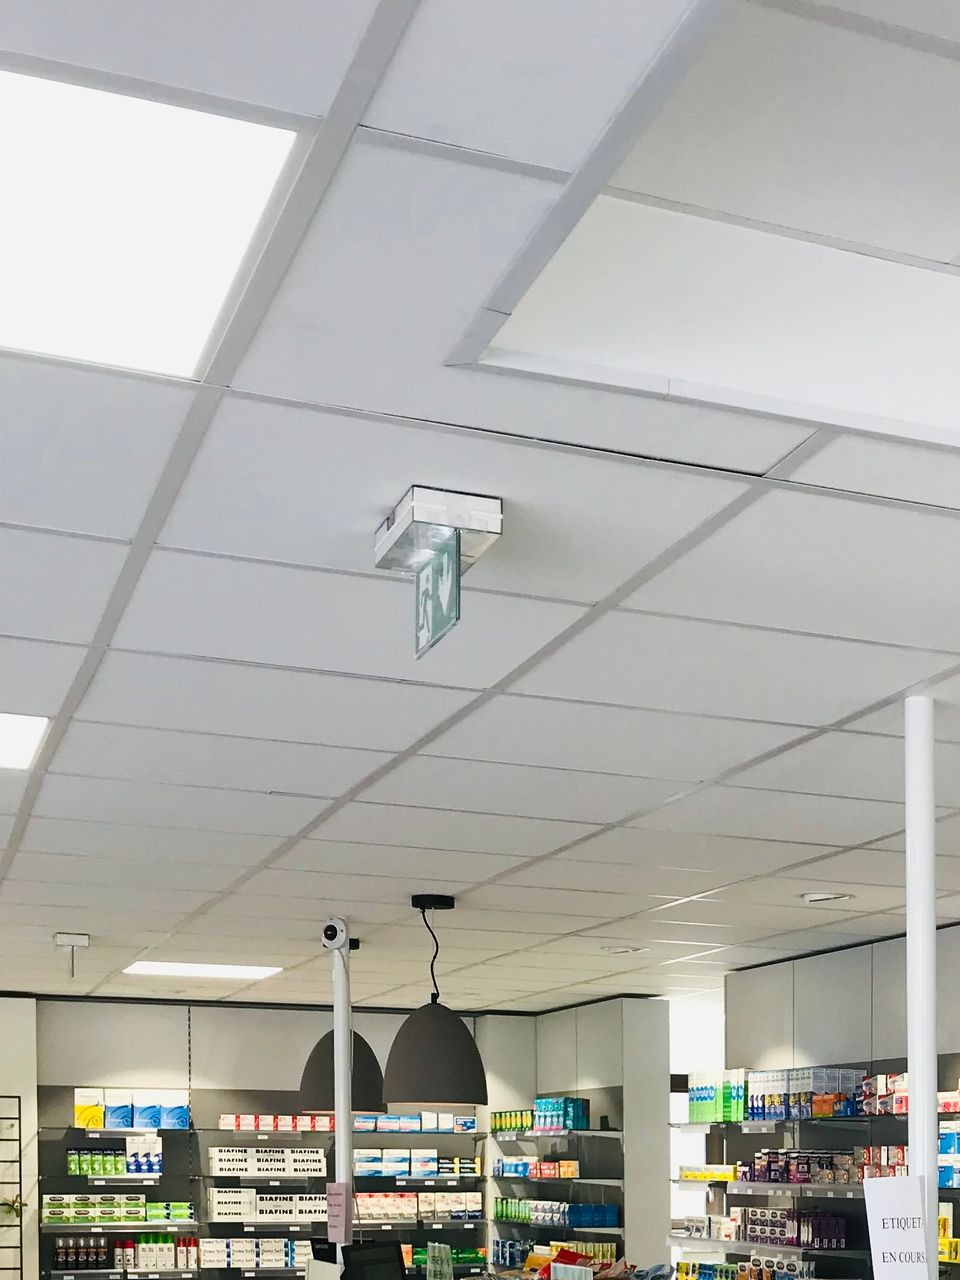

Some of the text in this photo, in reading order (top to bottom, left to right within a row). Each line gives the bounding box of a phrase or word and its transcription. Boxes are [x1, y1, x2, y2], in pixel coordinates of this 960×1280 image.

[882, 1216, 923, 1231] ETIQUET
[882, 1251, 925, 1263] EN COURS
